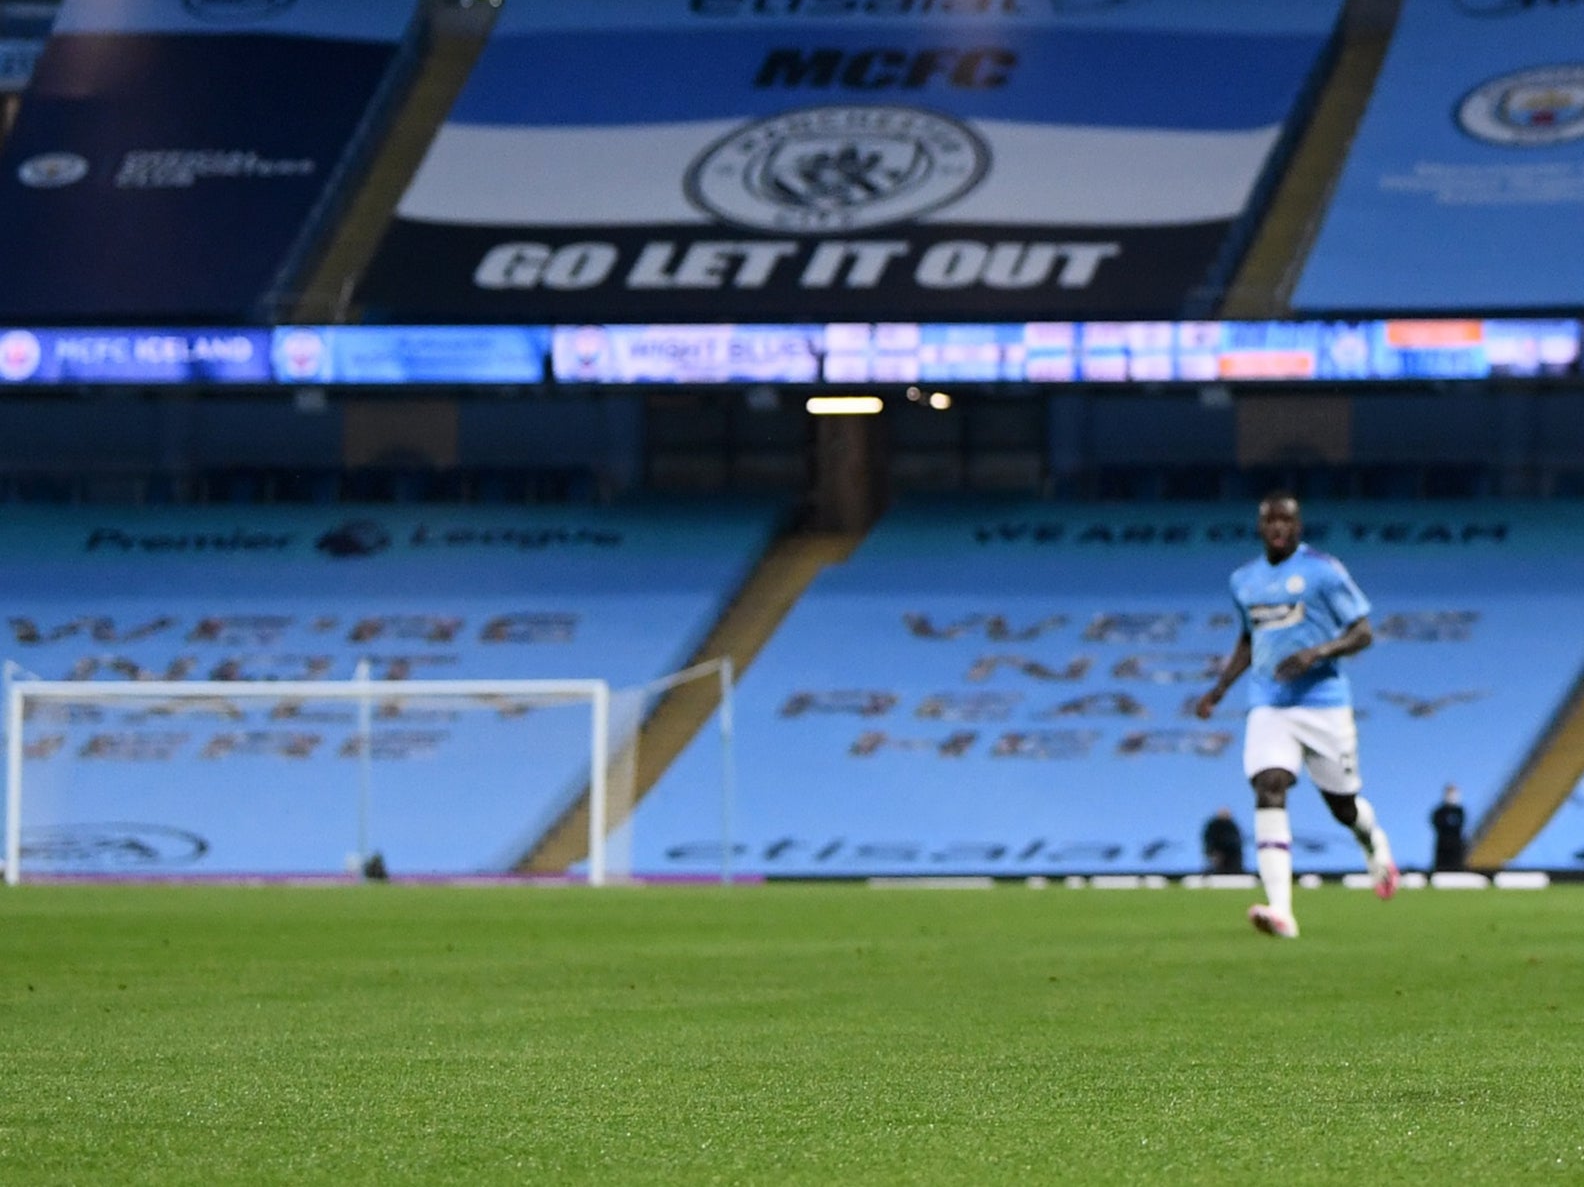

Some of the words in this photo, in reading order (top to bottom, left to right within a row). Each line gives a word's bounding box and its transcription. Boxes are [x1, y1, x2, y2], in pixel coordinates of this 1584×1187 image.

[754, 47, 1019, 90] MCFC
[474, 240, 612, 291] GO
[625, 240, 796, 290] LET
[799, 239, 911, 290] IT
[914, 240, 1120, 290] OUT
[1348, 522, 1510, 544] TEAM
